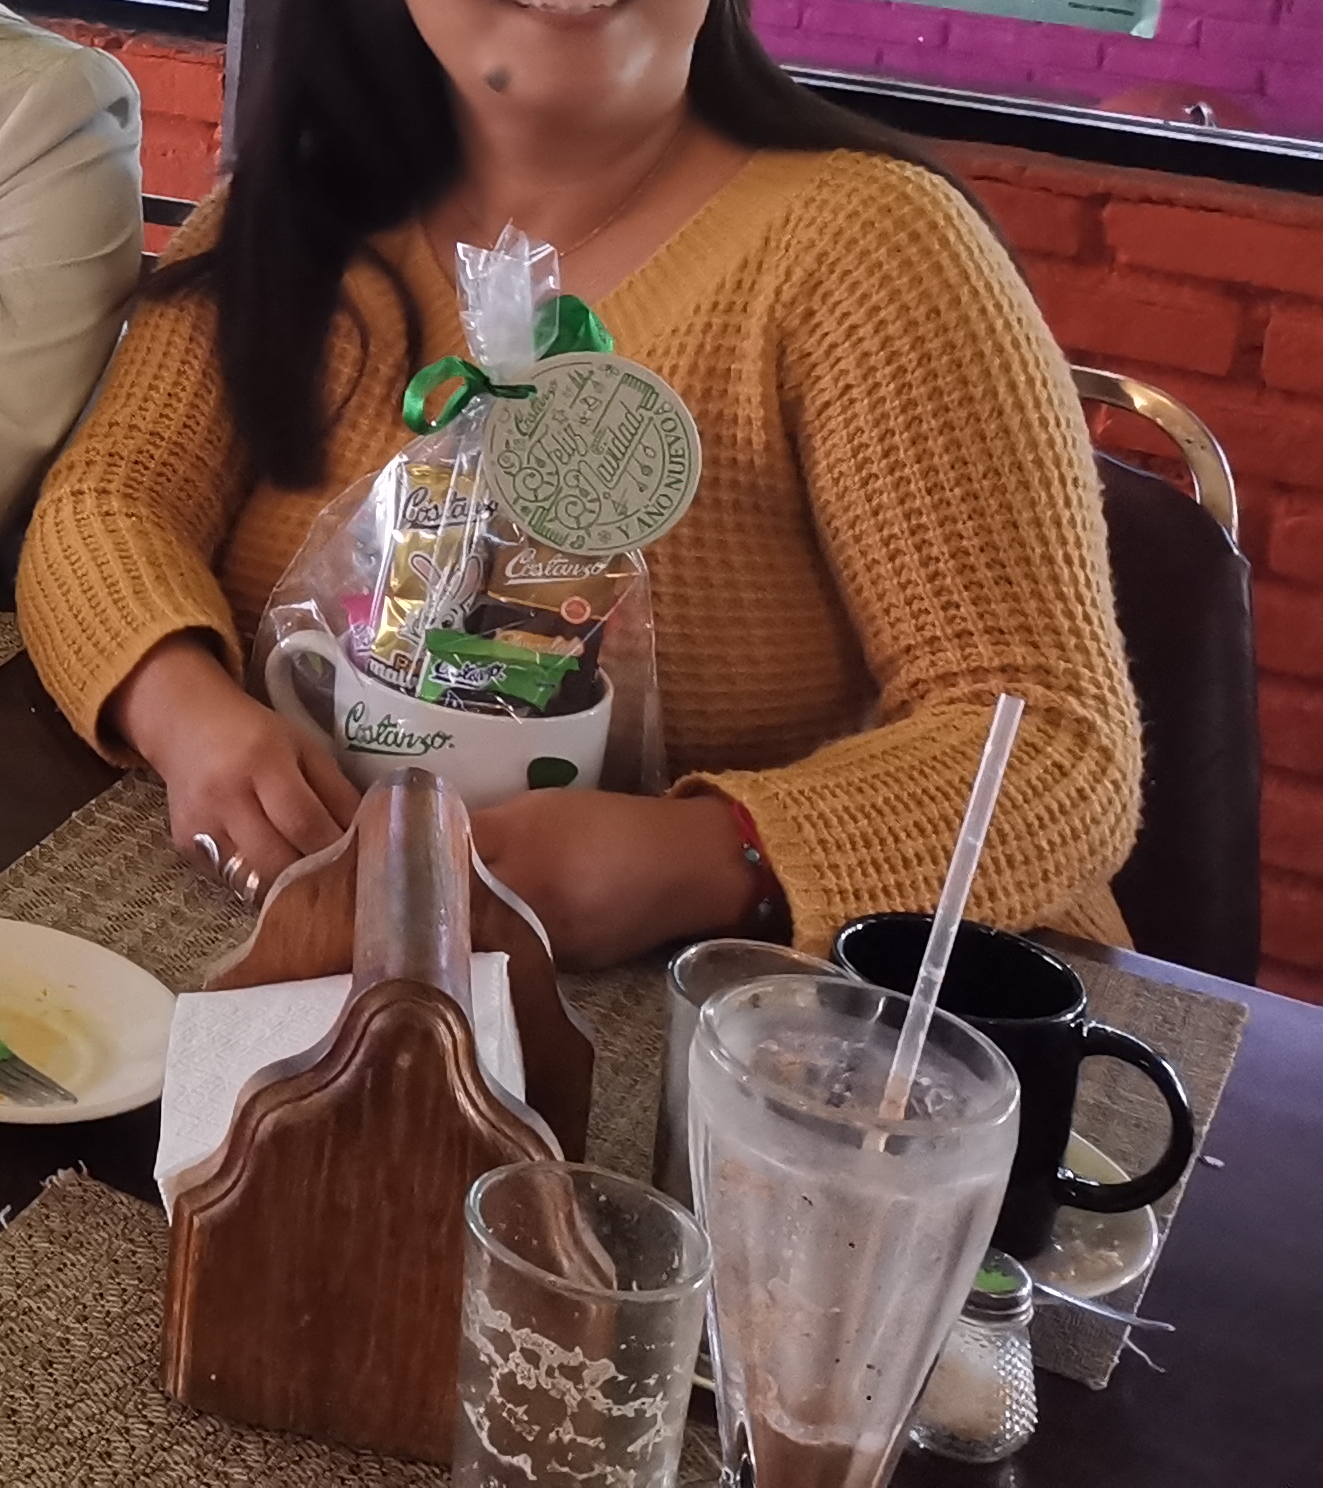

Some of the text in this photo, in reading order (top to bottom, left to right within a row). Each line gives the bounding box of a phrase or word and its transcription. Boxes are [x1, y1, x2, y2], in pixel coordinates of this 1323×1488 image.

[577, 399, 645, 490] Navidad
[617, 416, 687, 541] Y AÑO NUEVO
[504, 547, 608, 582] Costanzo
[344, 700, 453, 755] Costanzo
